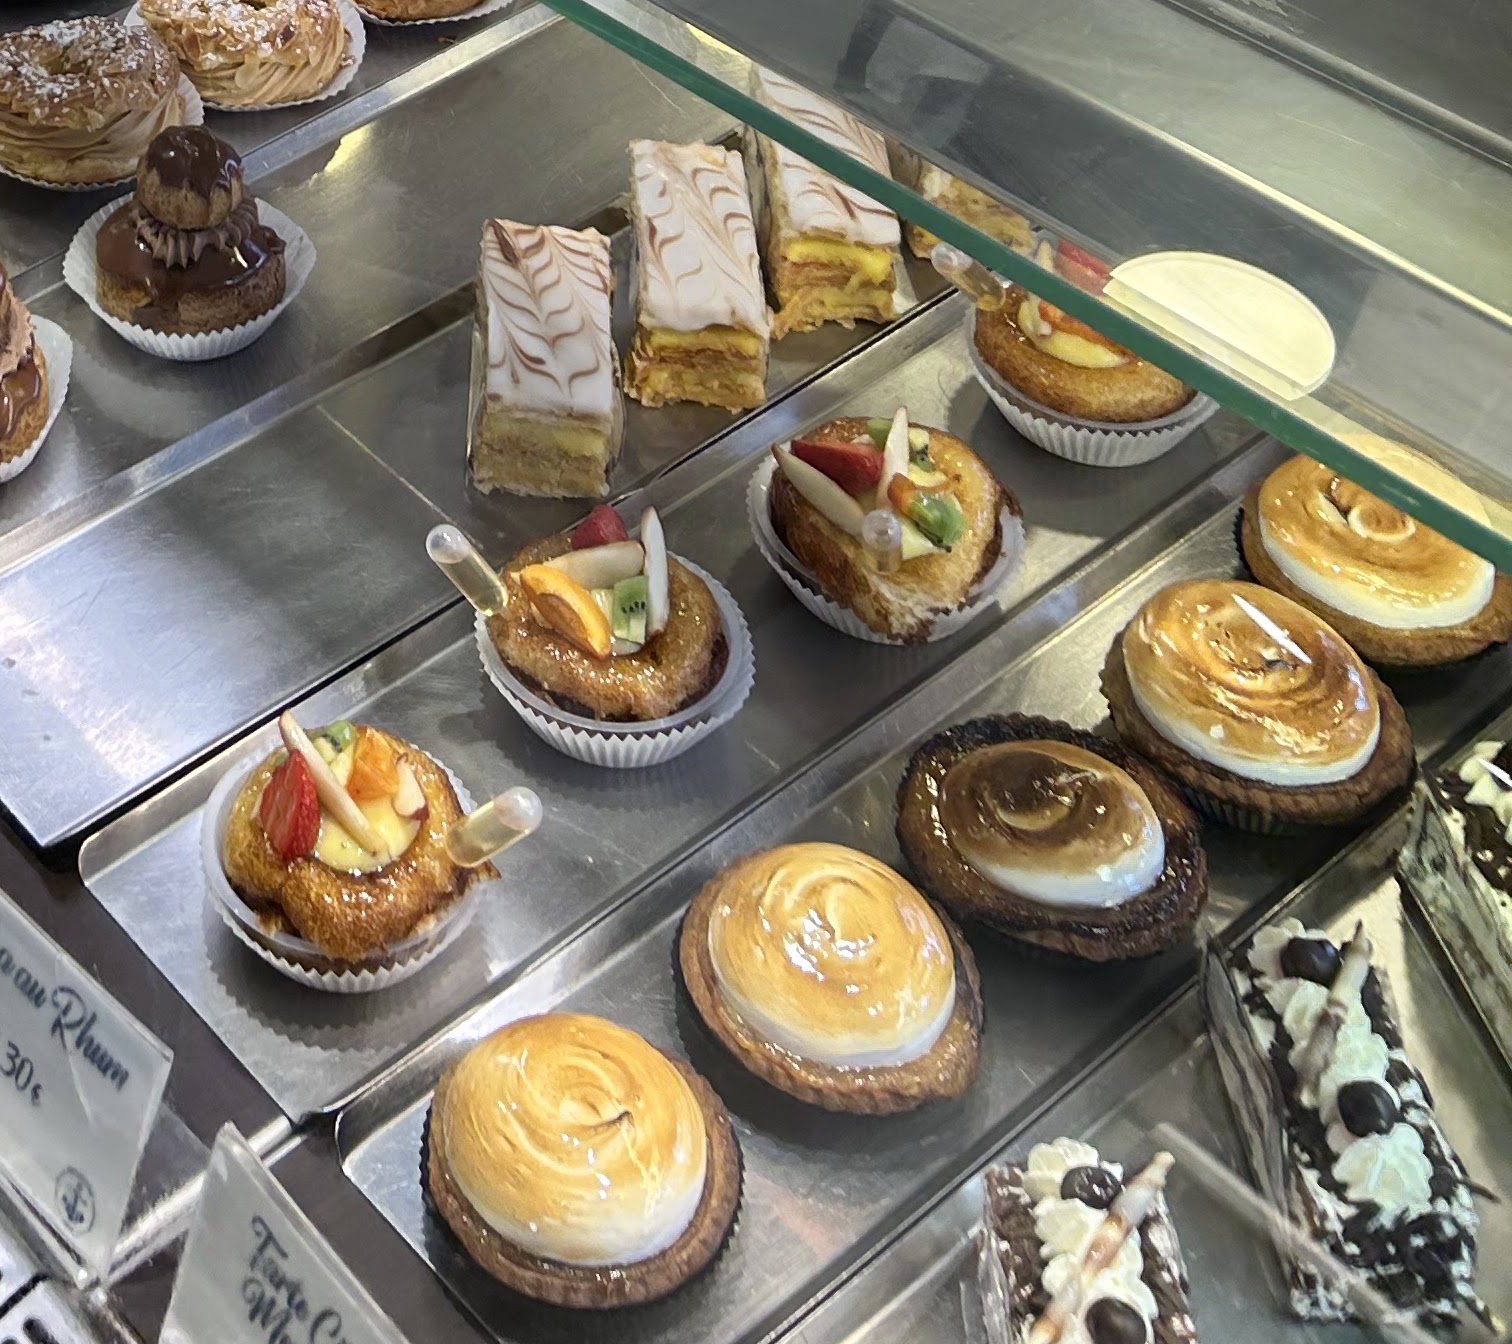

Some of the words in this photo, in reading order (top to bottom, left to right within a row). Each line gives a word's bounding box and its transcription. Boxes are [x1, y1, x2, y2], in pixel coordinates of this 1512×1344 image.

[12, 966, 48, 1010] au
[50, 984, 131, 1092] Rhum
[248, 1214, 310, 1322] Tarte
